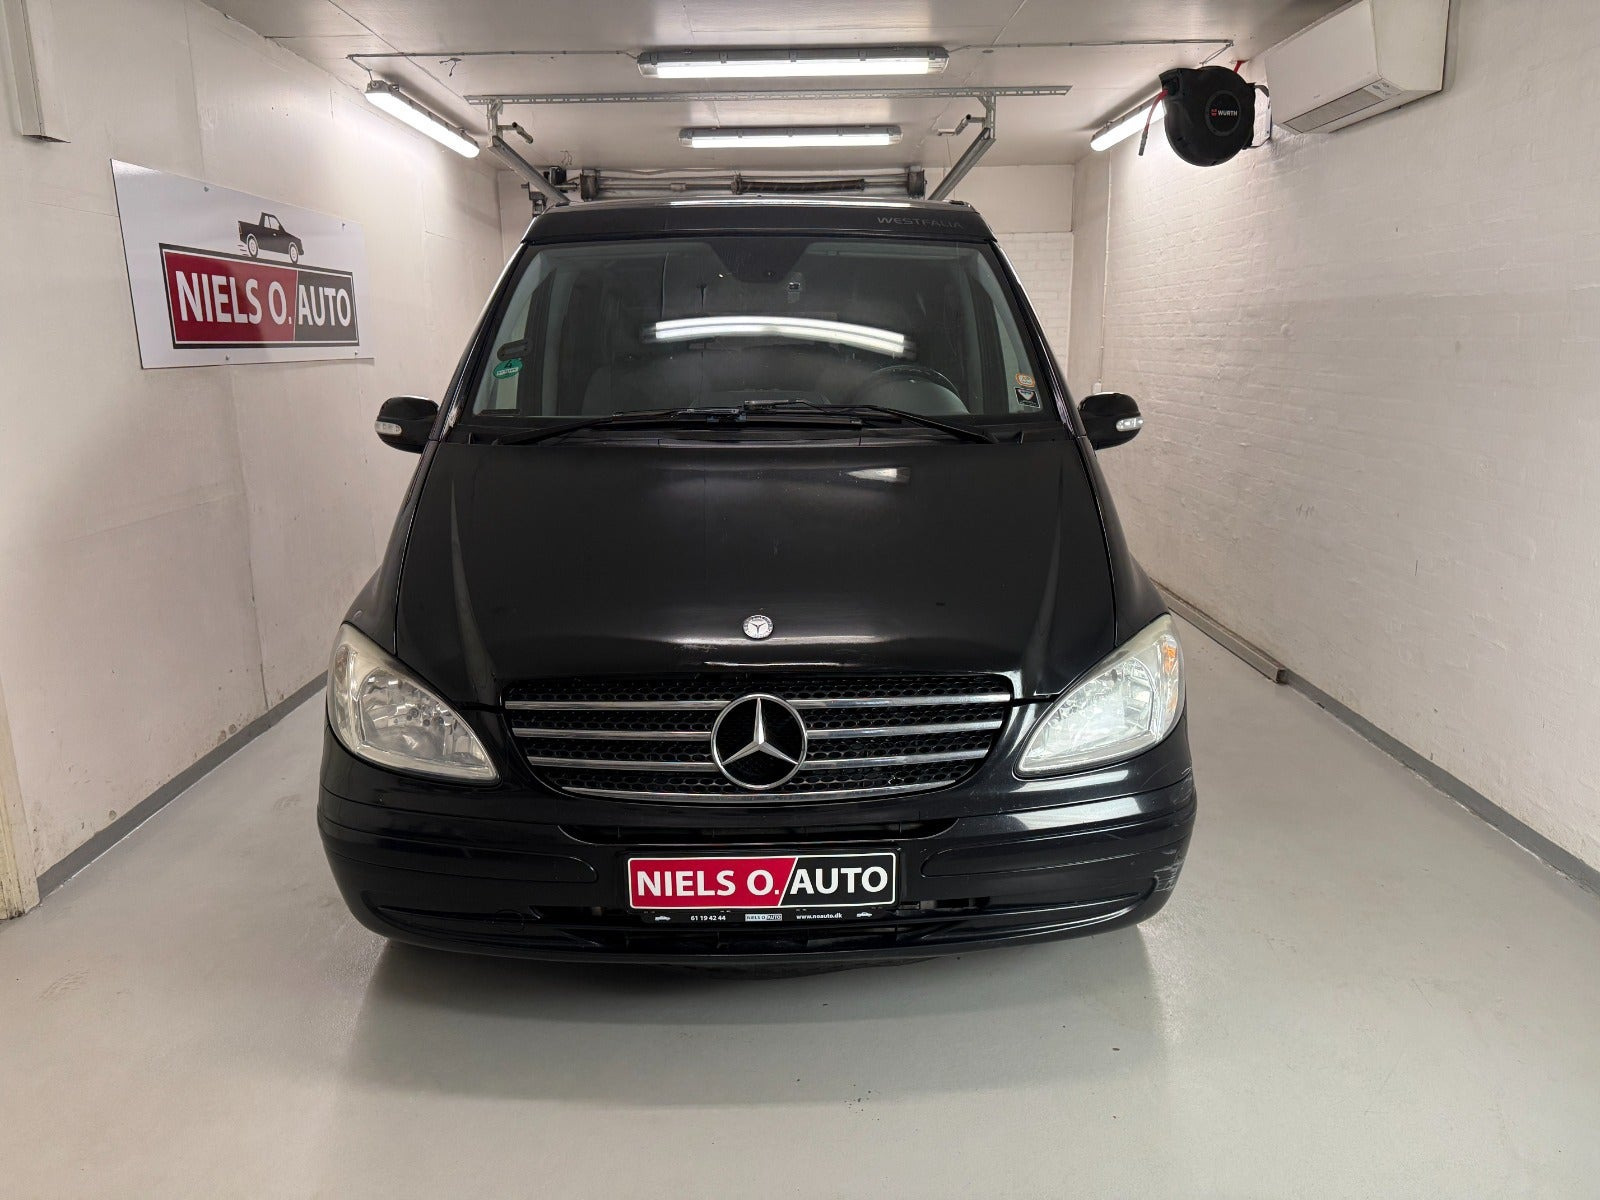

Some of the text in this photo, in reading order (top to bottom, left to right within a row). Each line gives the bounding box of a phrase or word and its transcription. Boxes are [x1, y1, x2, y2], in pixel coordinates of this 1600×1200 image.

[877, 216, 964, 230] WESTFALIA
[175, 270, 351, 327] NIELS O. AUTO
[637, 866, 889, 897] NIELS O. AUTO
[796, 912, 843, 920] www.noauto.dk
